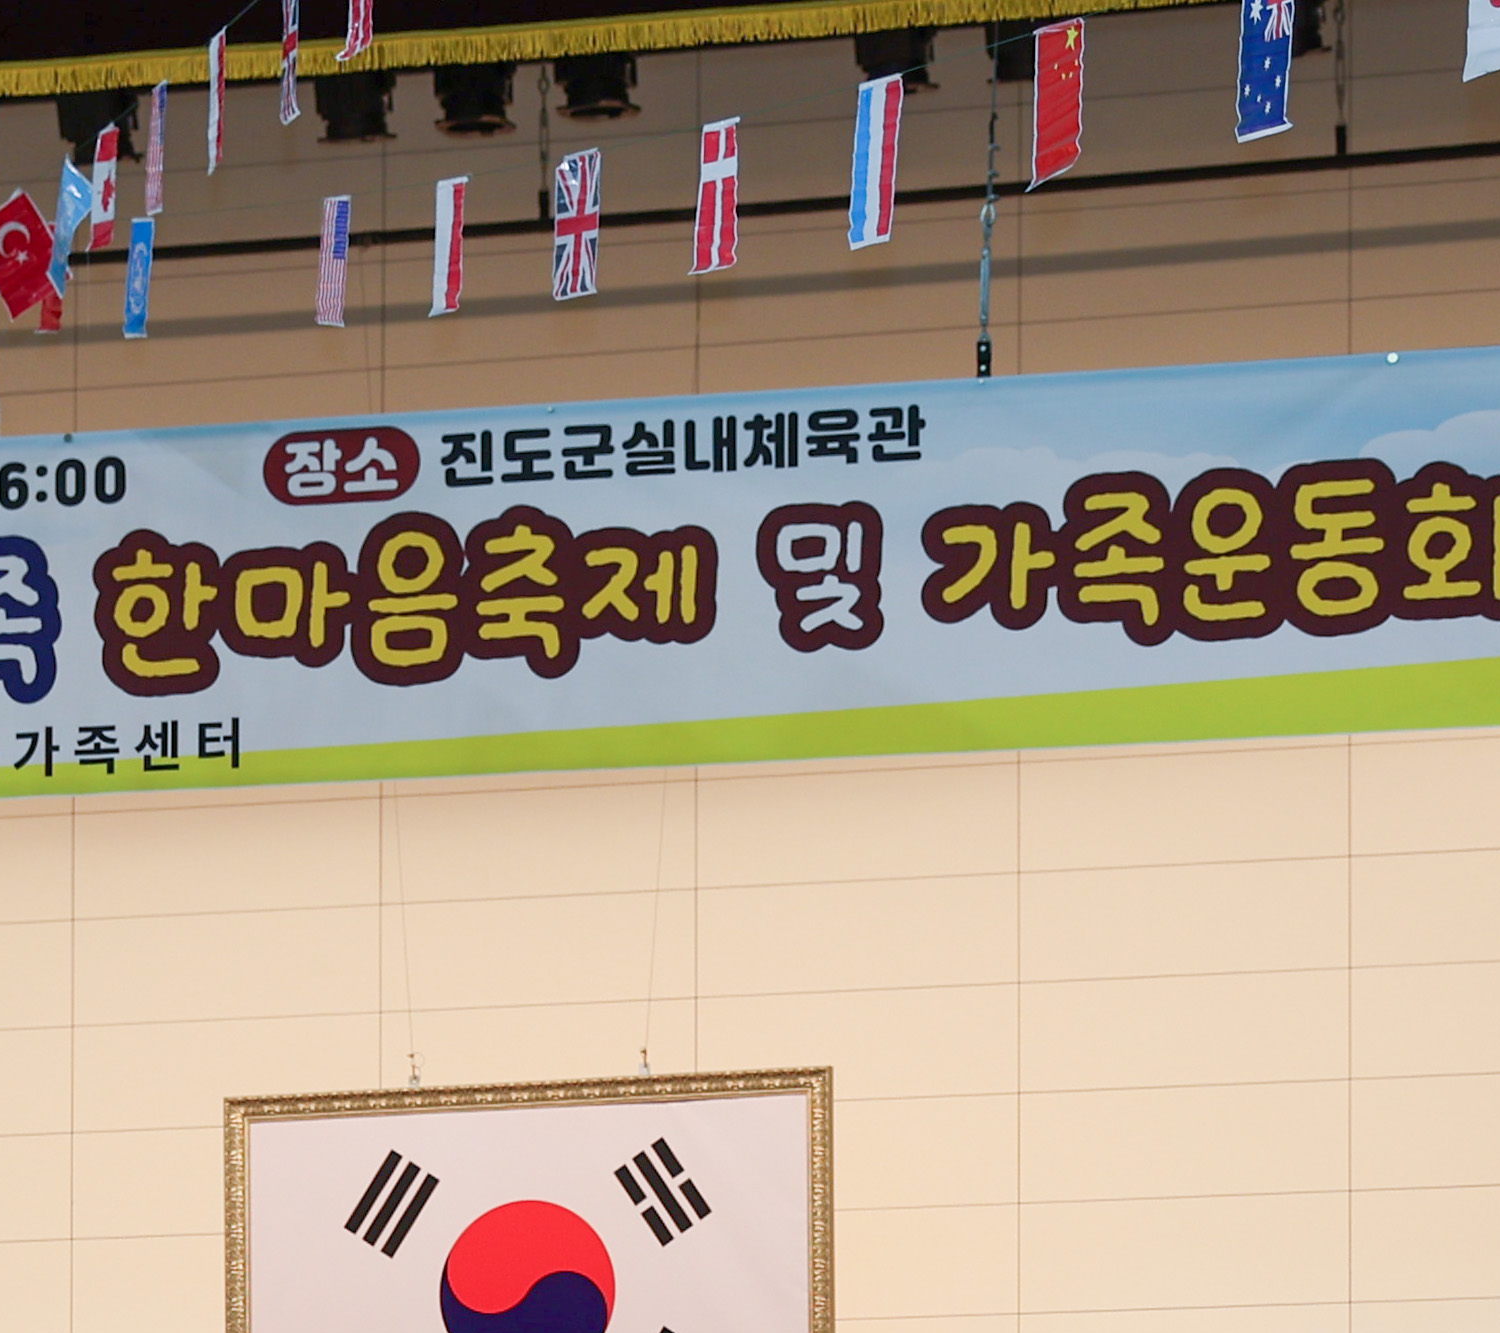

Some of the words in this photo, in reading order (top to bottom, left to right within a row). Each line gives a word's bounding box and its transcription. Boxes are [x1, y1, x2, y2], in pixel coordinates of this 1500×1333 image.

[284, 438, 399, 497] 장소
[440, 404, 926, 488] 진도군실내체육관
[100, 511, 711, 690] 한마음축제
[762, 507, 878, 647] 및
